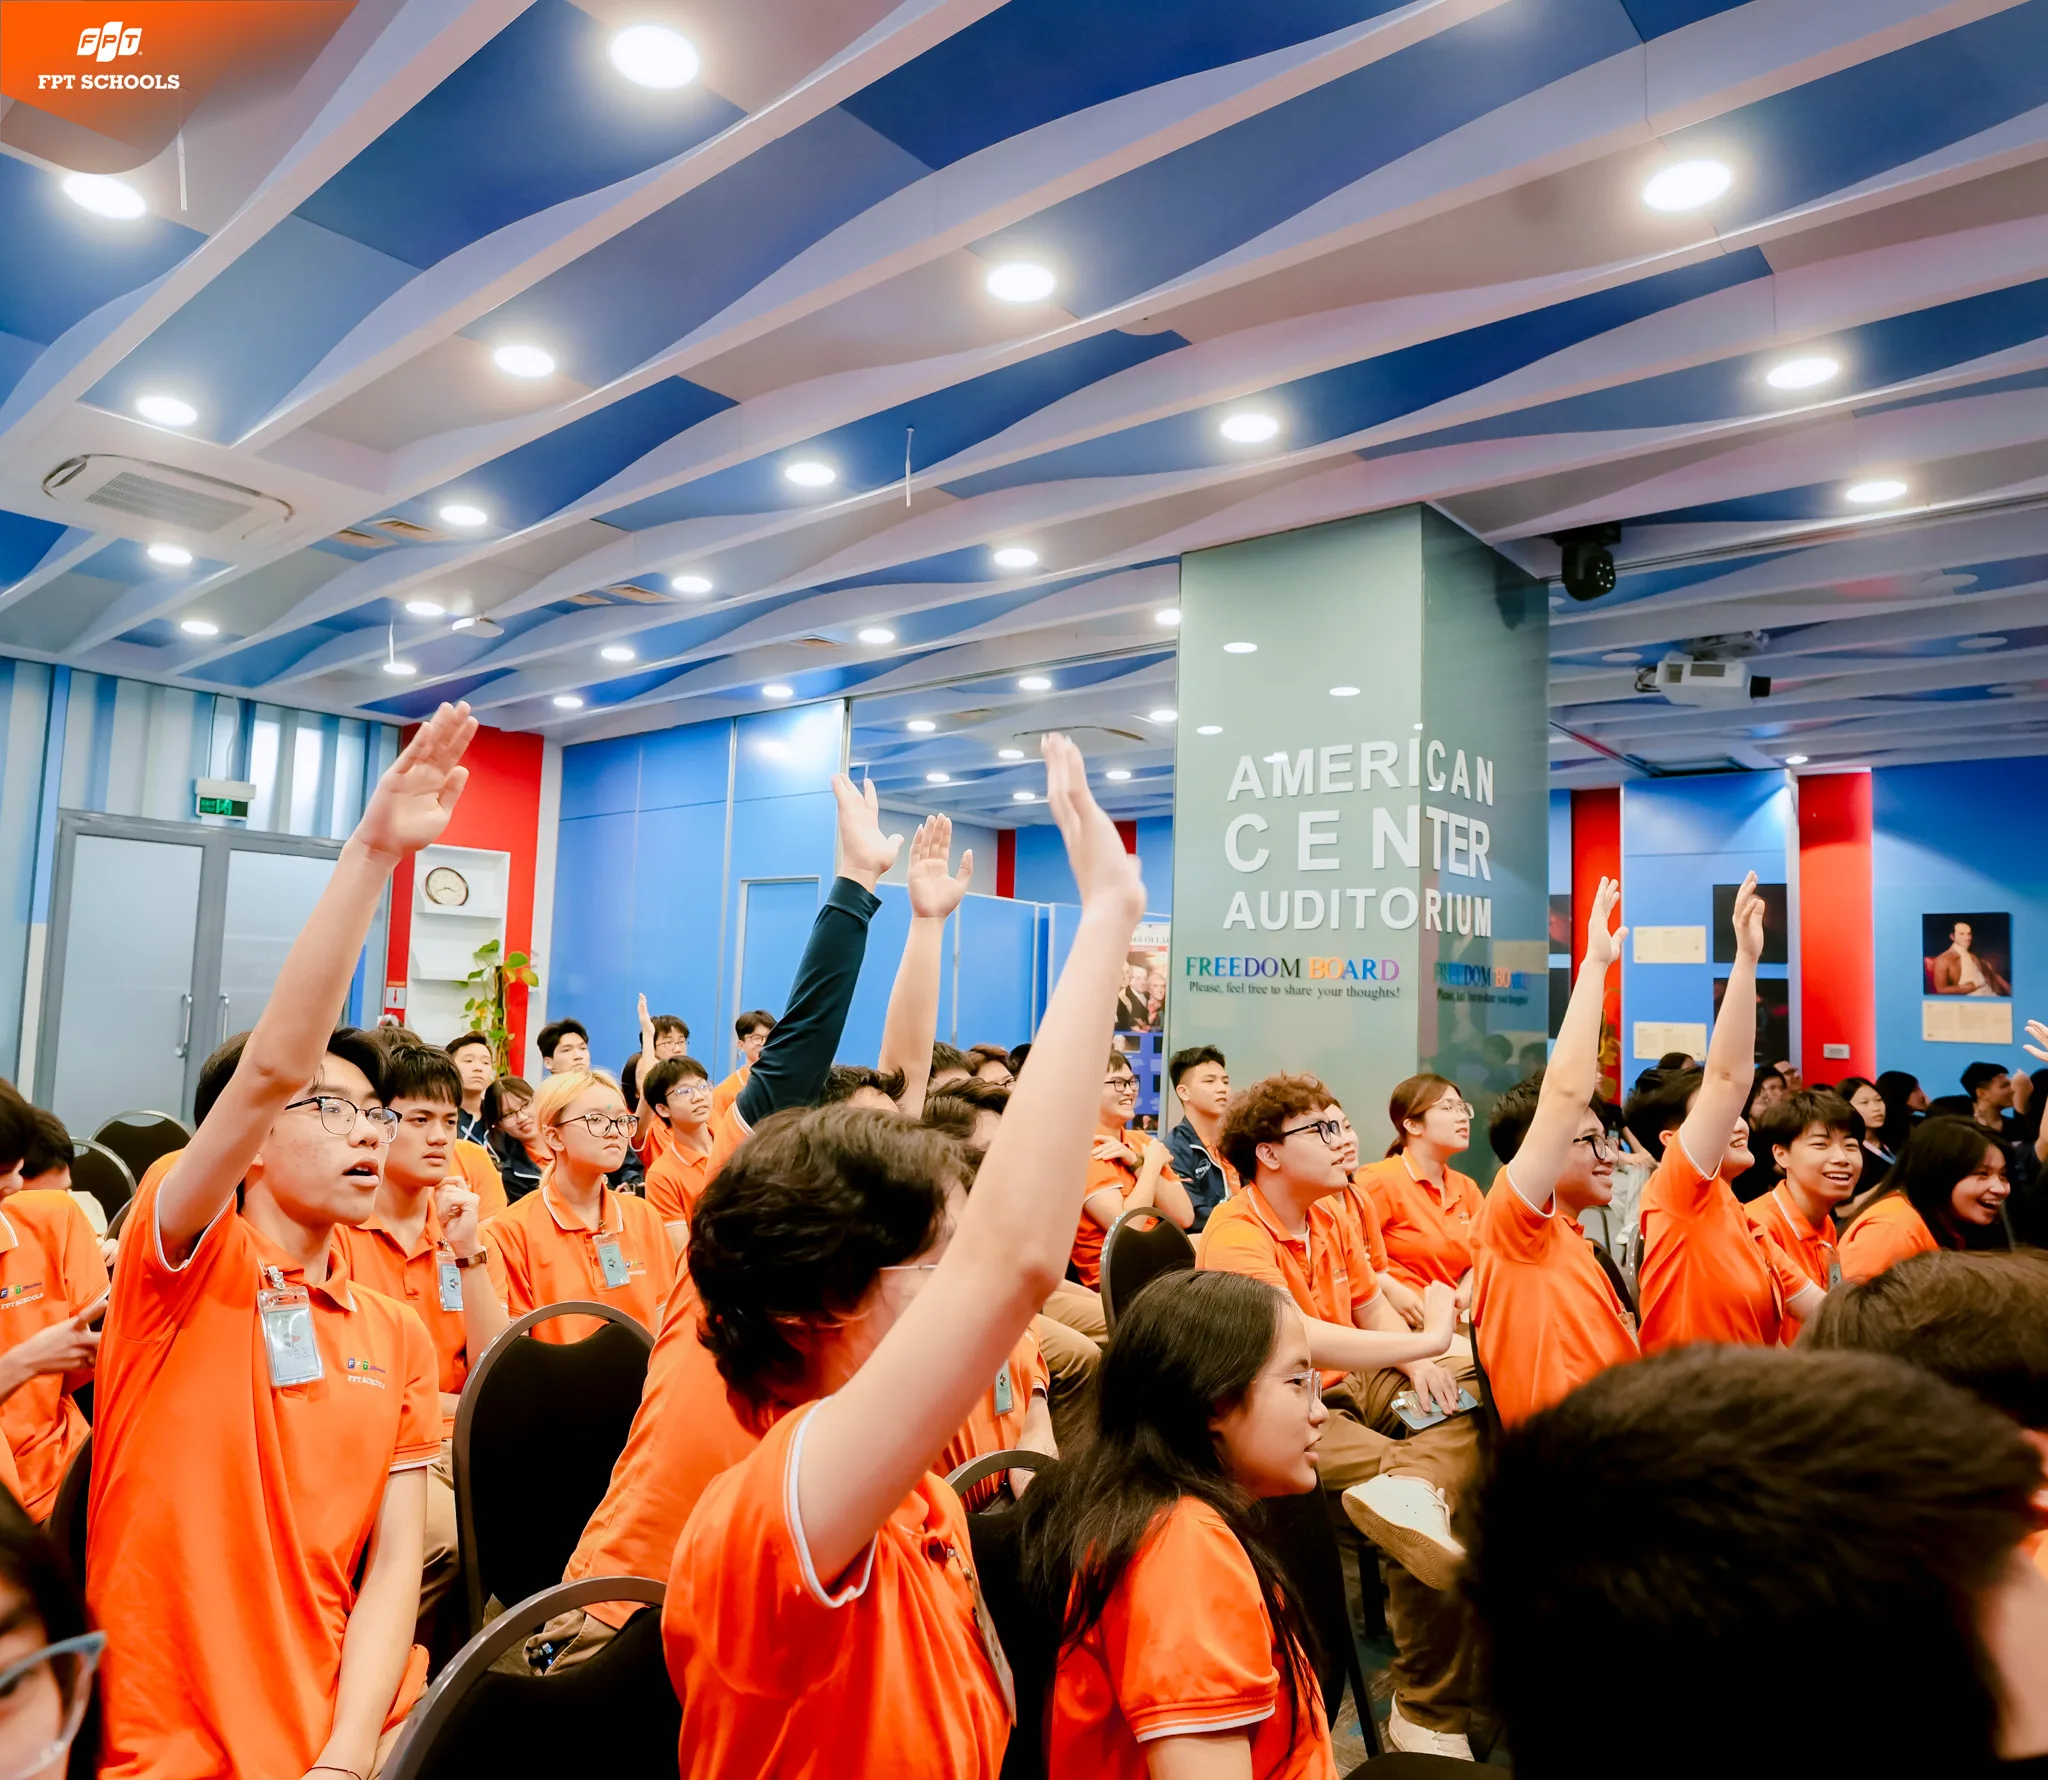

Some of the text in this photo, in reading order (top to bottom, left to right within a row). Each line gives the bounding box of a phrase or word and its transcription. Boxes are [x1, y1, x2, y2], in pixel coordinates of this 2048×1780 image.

[1226, 737, 1494, 806] AMERICAN
[1224, 804, 1492, 882] CENTER
[1223, 887, 1492, 938] AUDITORIUM
[1185, 956, 1400, 981] FREEDOM BOARD
[1495, 967, 1530, 990] BOD
[1226, 981, 1245, 994] feel
[1248, 982, 1269, 995] free
[1270, 984, 1281, 995] to
[1284, 984, 1312, 997] share
[1317, 987, 1342, 1000] your
[1346, 986, 1400, 1001] thoughts!
